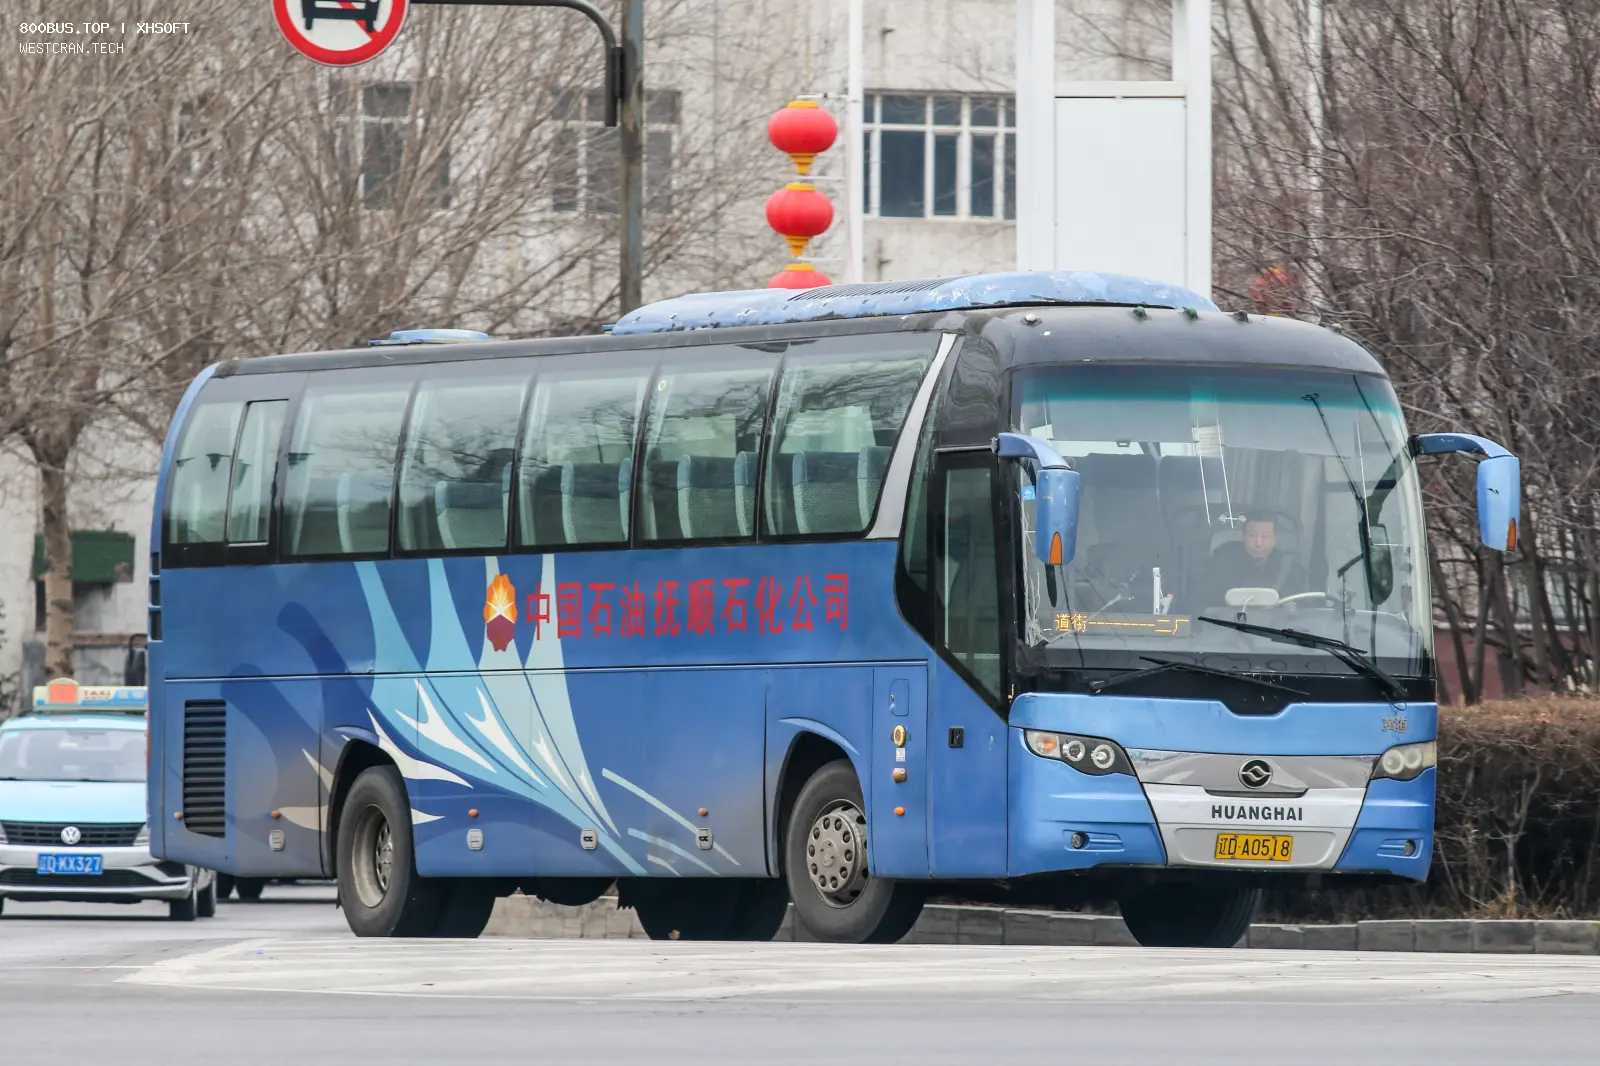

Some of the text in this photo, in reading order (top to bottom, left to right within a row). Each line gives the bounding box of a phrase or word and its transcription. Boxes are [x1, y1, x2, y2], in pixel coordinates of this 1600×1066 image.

[526, 573, 850, 641] 中国石油抚顺石化公司
[1211, 804, 1303, 822] HUANGHAI
